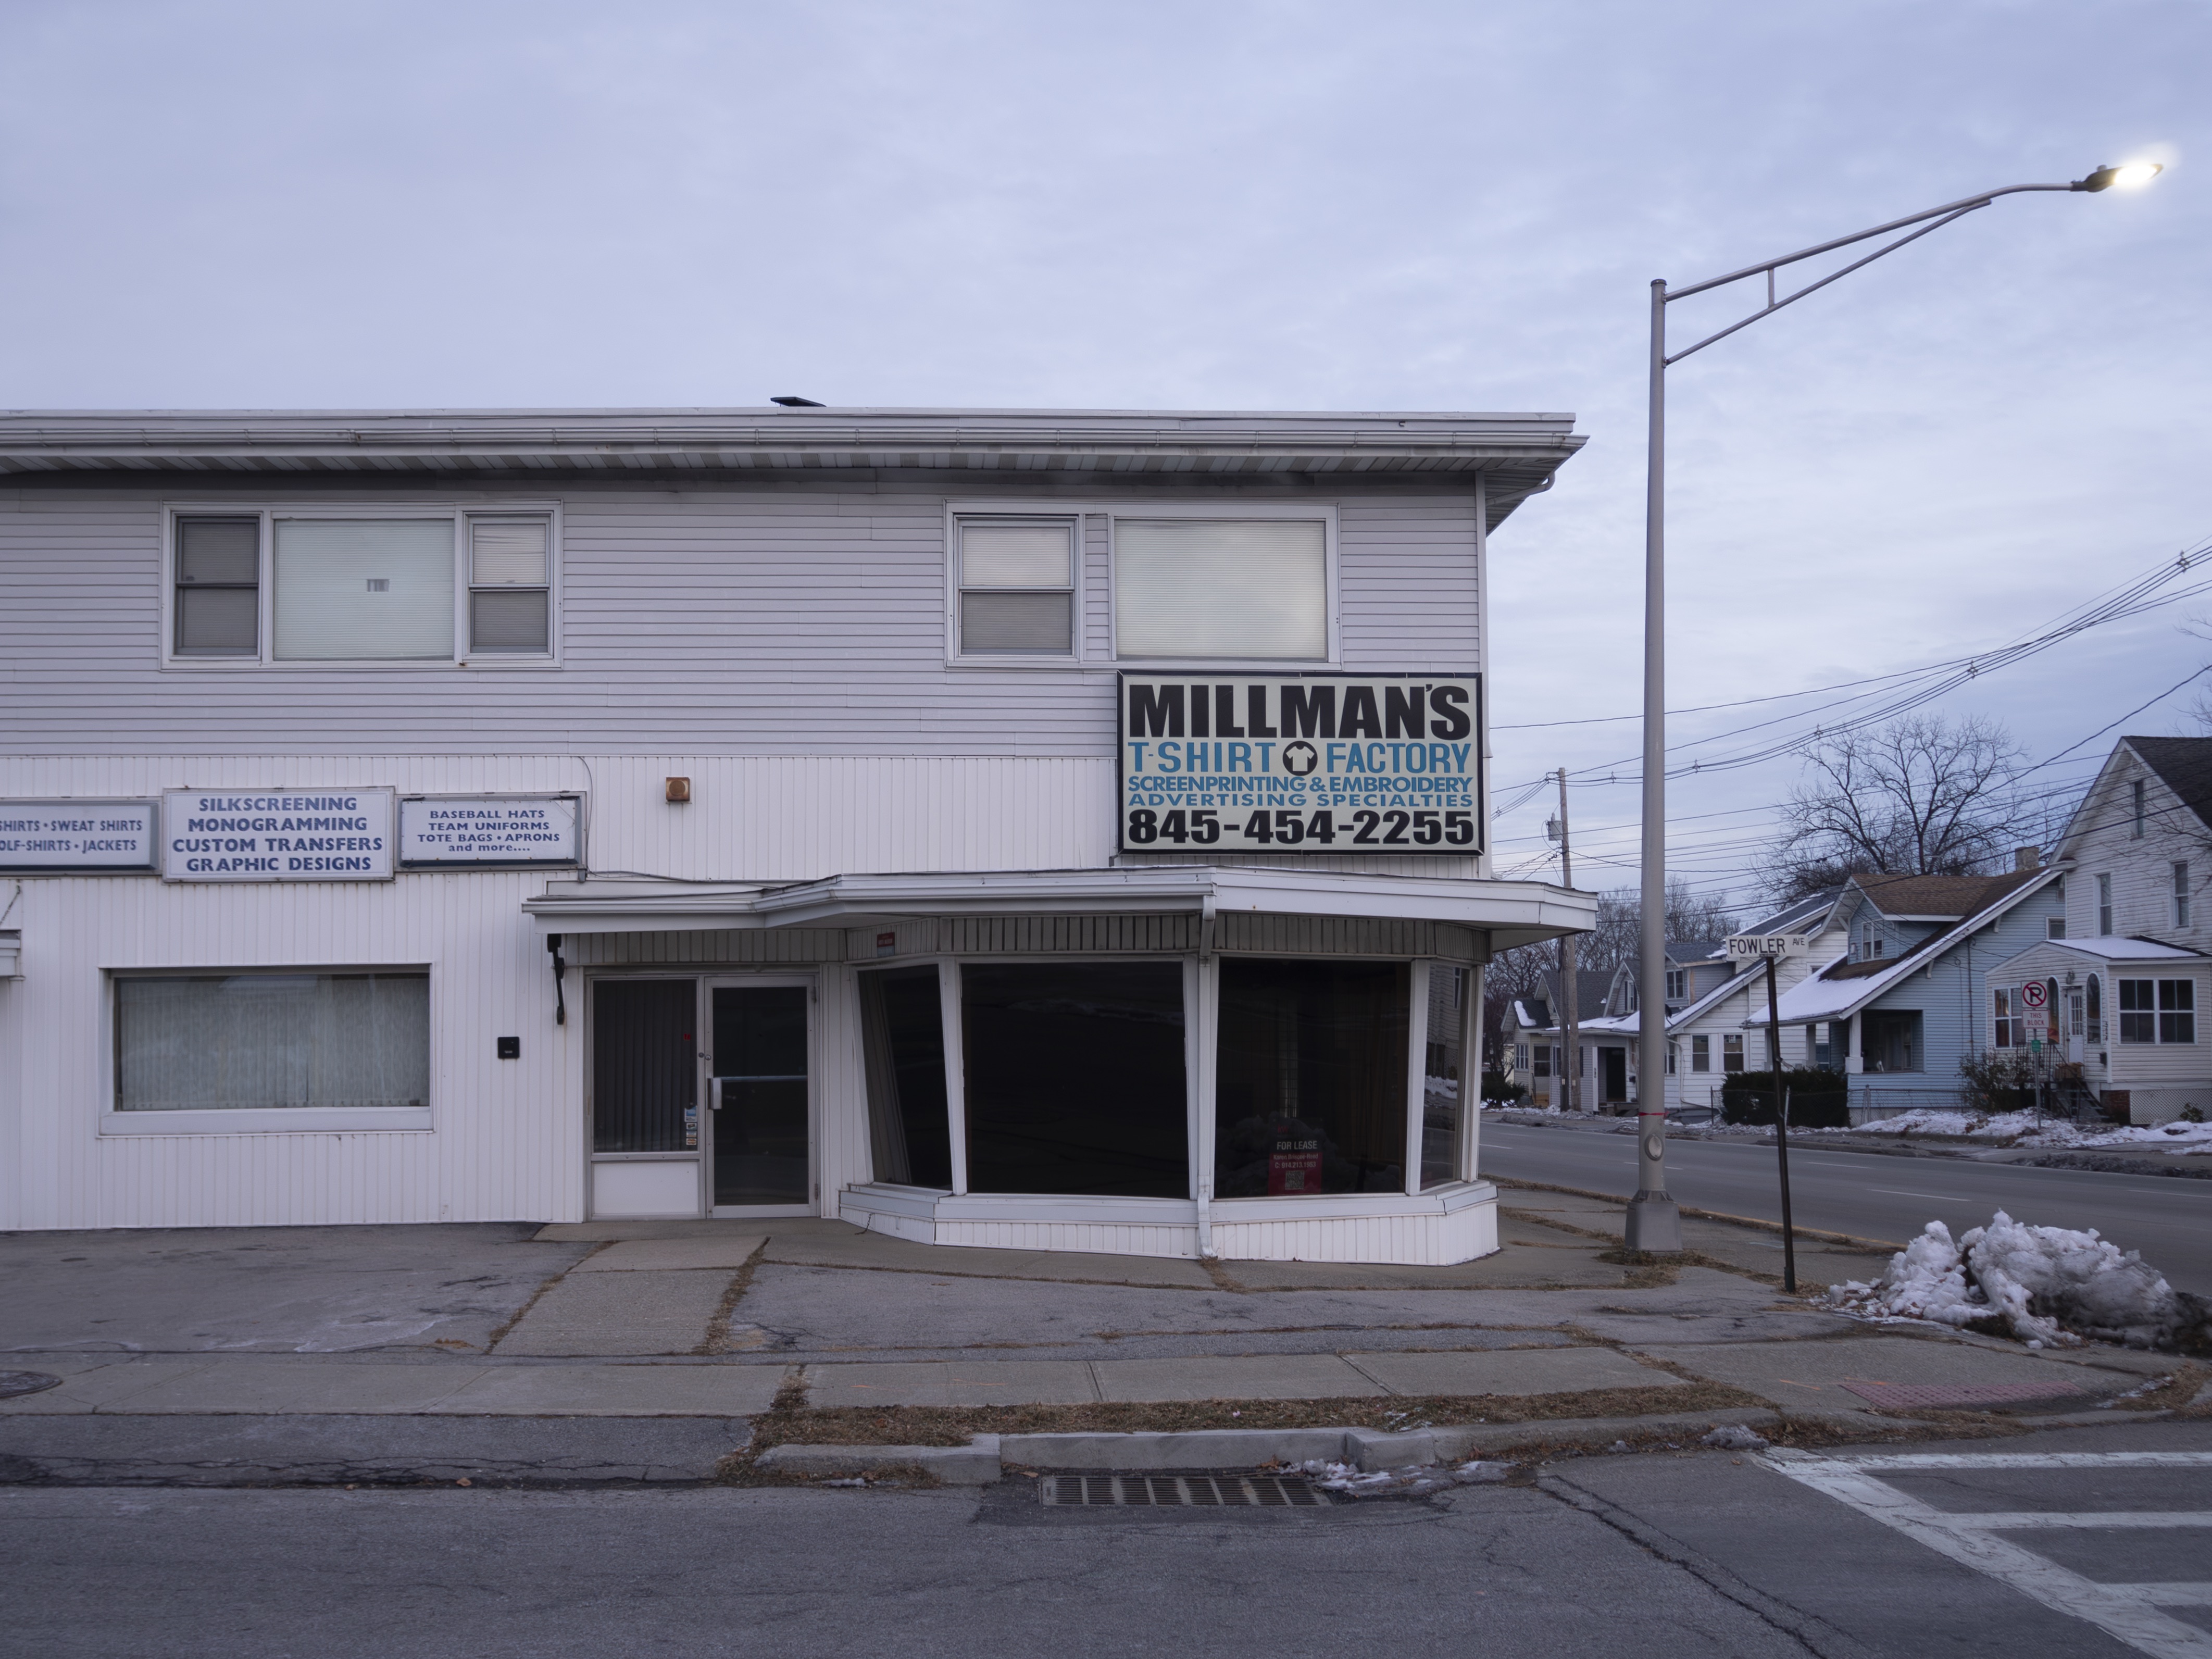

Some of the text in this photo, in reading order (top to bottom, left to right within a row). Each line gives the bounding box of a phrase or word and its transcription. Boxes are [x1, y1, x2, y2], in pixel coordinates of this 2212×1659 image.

[1129, 684, 1471, 741] MILLMAN'S
[1128, 741, 1471, 774] T-SHIRT FACTORY
[1128, 776, 1473, 792] SCREENPRINTING & EMBROIDERY
[199, 797, 357, 812] SILKSCREENING
[1128, 793, 1473, 807] ADVERTISING SPECIALTIES
[430, 810, 544, 819] BASEBALL HATS
[51, 820, 95, 831] SWEAT
[100, 820, 142, 831] SHIRTS
[188, 817, 367, 832] MONOGRAMMING
[428, 822, 549, 831] TEAM UNIFORMS
[1128, 809, 1474, 844] 845-454-2255
[172, 837, 382, 853] CUSTOM TRANSFERS
[417, 833, 560, 842] TOTE BAGS APRONS
[82, 840, 136, 854] JACKETS
[448, 843, 472, 852] and
[186, 857, 371, 872] GRAPHIC DESIGNS
[1729, 938, 1805, 954] FOWLER AVE
[1277, 1140, 1317, 1150] FOR LEASE
